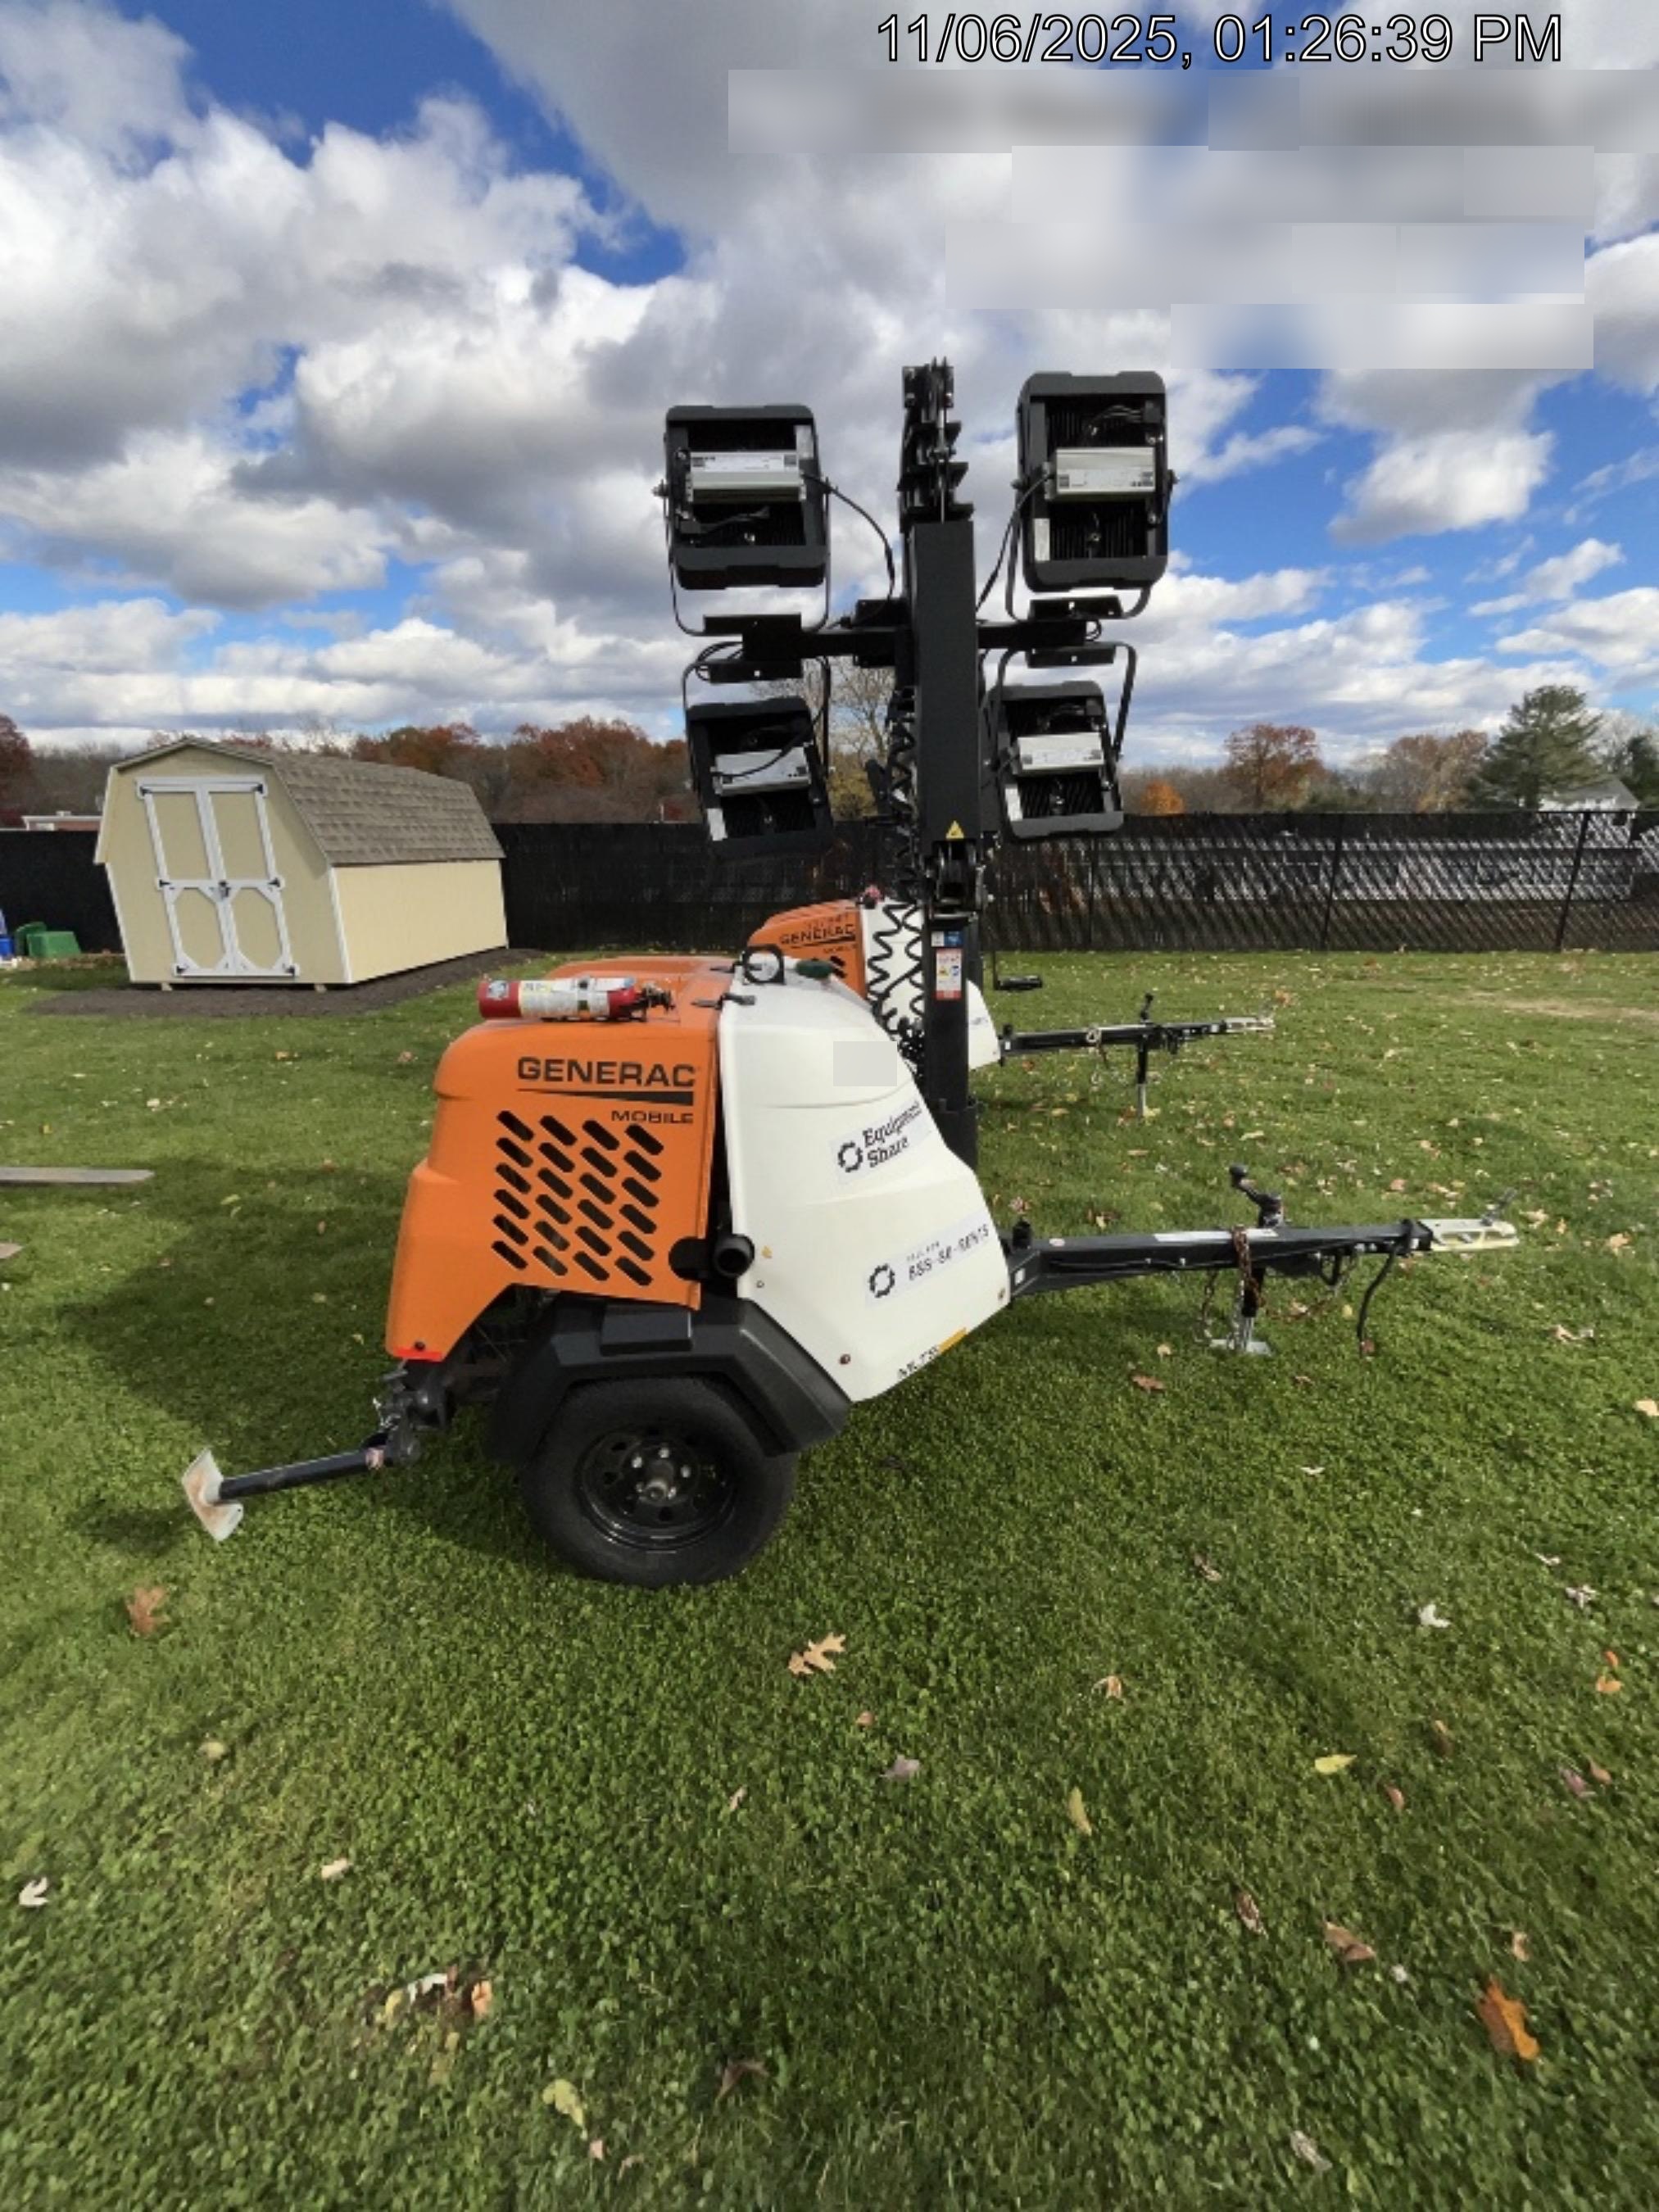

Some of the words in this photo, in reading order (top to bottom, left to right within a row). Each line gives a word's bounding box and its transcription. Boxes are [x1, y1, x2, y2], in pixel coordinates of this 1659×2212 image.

[517, 1056, 696, 1088] GENERAC
[610, 1109, 695, 1125] MOBILE
[867, 1135, 909, 1168] Share
